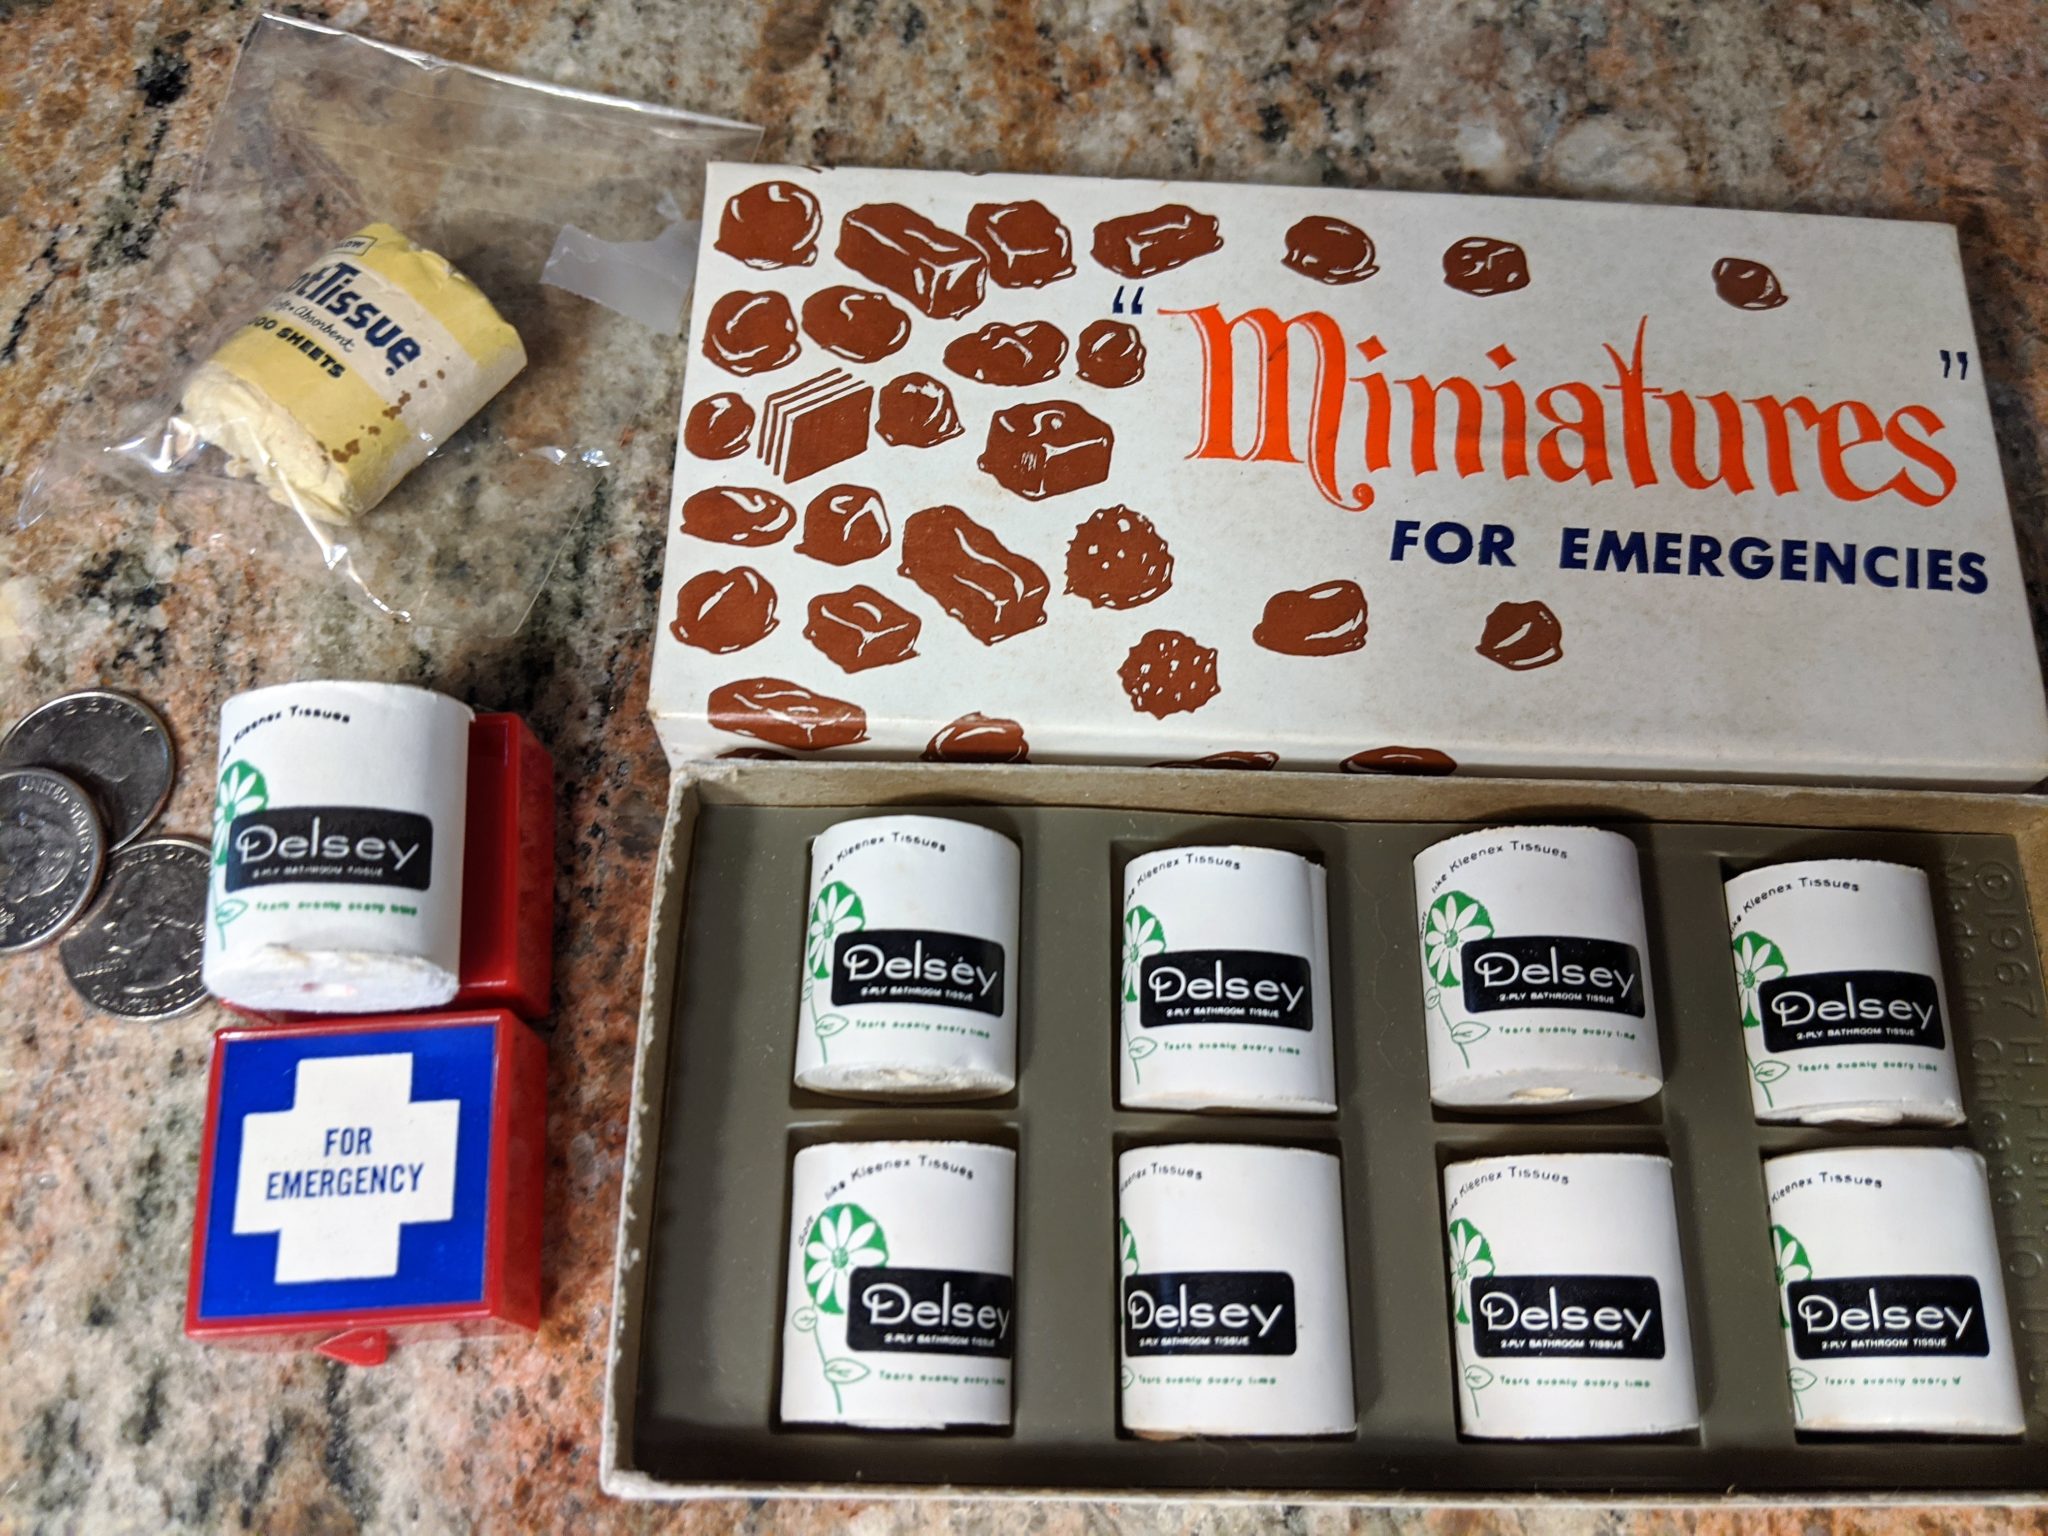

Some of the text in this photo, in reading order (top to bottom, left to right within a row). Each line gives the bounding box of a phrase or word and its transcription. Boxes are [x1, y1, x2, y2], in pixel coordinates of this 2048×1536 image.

[248, 316, 346, 378] 00 SHEETS
[1390, 519, 1988, 594] FOR EMERGENCIES
[235, 816, 419, 870] Delsey
[892, 832, 946, 853] Tissues
[1450, 845, 1503, 873] Kleenex
[1510, 840, 1568, 860] Tissues
[1185, 853, 1241, 870] Tissues
[1743, 883, 1792, 913] Kleenex
[1798, 877, 1860, 892] Tissues
[842, 940, 997, 996] Delsey
[1474, 946, 1635, 999] Delsey
[1148, 959, 1304, 1012] Delsey
[1530, 992, 1582, 1000] BATHROOM
[1586, 994, 1614, 1004] TISSUE
[1193, 1007, 1245, 1015] BATHROOM
[1771, 982, 1933, 1030] Delsey
[1827, 1027, 1881, 1037] BATHROOM
[1886, 1028, 1915, 1036] TISSUE
[324, 1127, 372, 1157] FOR
[266, 1163, 424, 1199] EMERGENCY
[851, 1159, 910, 1181] Kleenex
[919, 1154, 974, 1180] Tissues
[1151, 1162, 1202, 1180] Tissues
[1459, 1171, 1502, 1198] Kleenex
[1508, 1165, 1569, 1185] Tissues
[1771, 1171, 1882, 1204] Kleenex Tissues
[862, 1281, 1010, 1339] Delsey
[1127, 1284, 1283, 1337] Delsey
[1479, 1286, 1651, 1341] Delsey
[1798, 1287, 1972, 1340] Delsey
[1529, 1338, 1585, 1348] BATHROOM
[1589, 1339, 1624, 1349] TISSUE
[1851, 1339, 1908, 1349] BATHROOM
[1913, 1338, 1947, 1348] TISSUE
